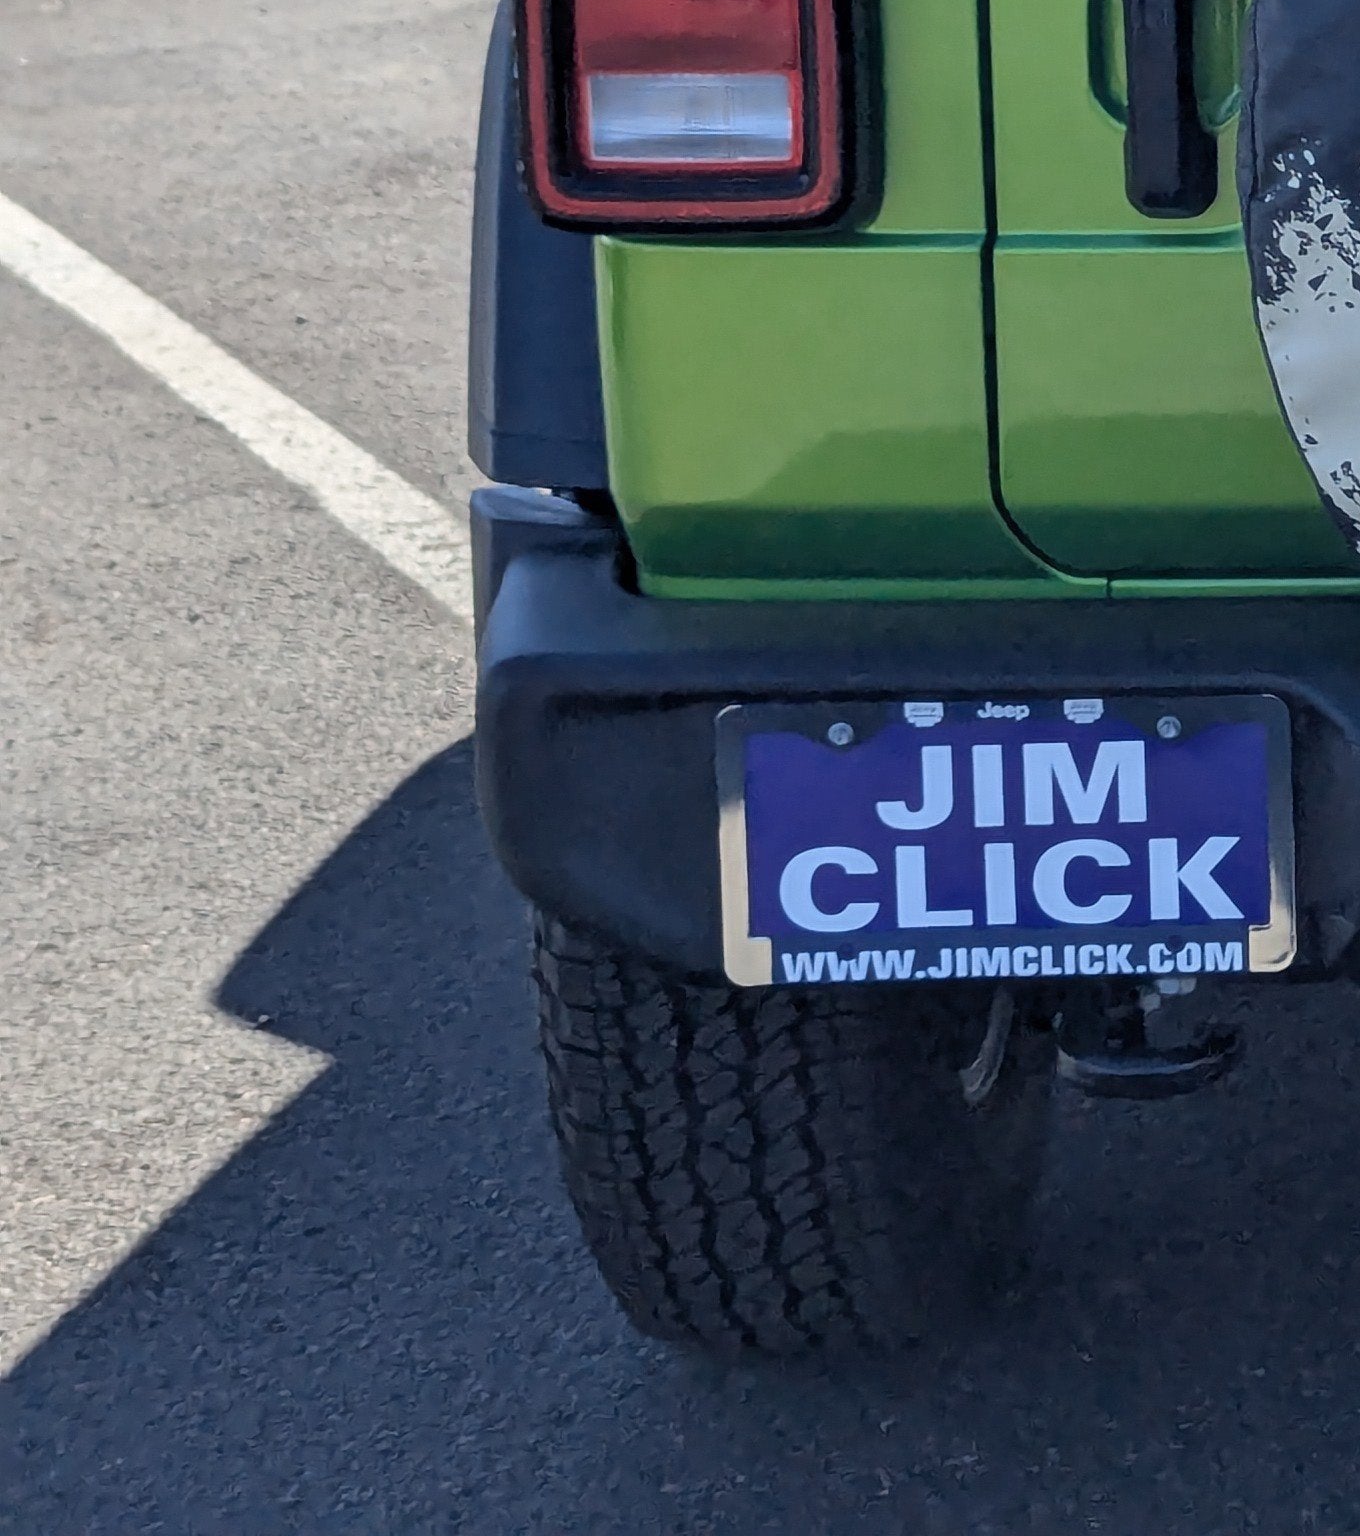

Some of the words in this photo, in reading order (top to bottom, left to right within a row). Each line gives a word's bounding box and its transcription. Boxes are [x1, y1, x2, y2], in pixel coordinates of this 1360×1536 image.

[976, 701, 1031, 721] Jeep
[875, 739, 1148, 831] JIM
[778, 835, 1245, 933] CLICK
[781, 940, 1244, 984] WWW.JIMCLICK.COM
